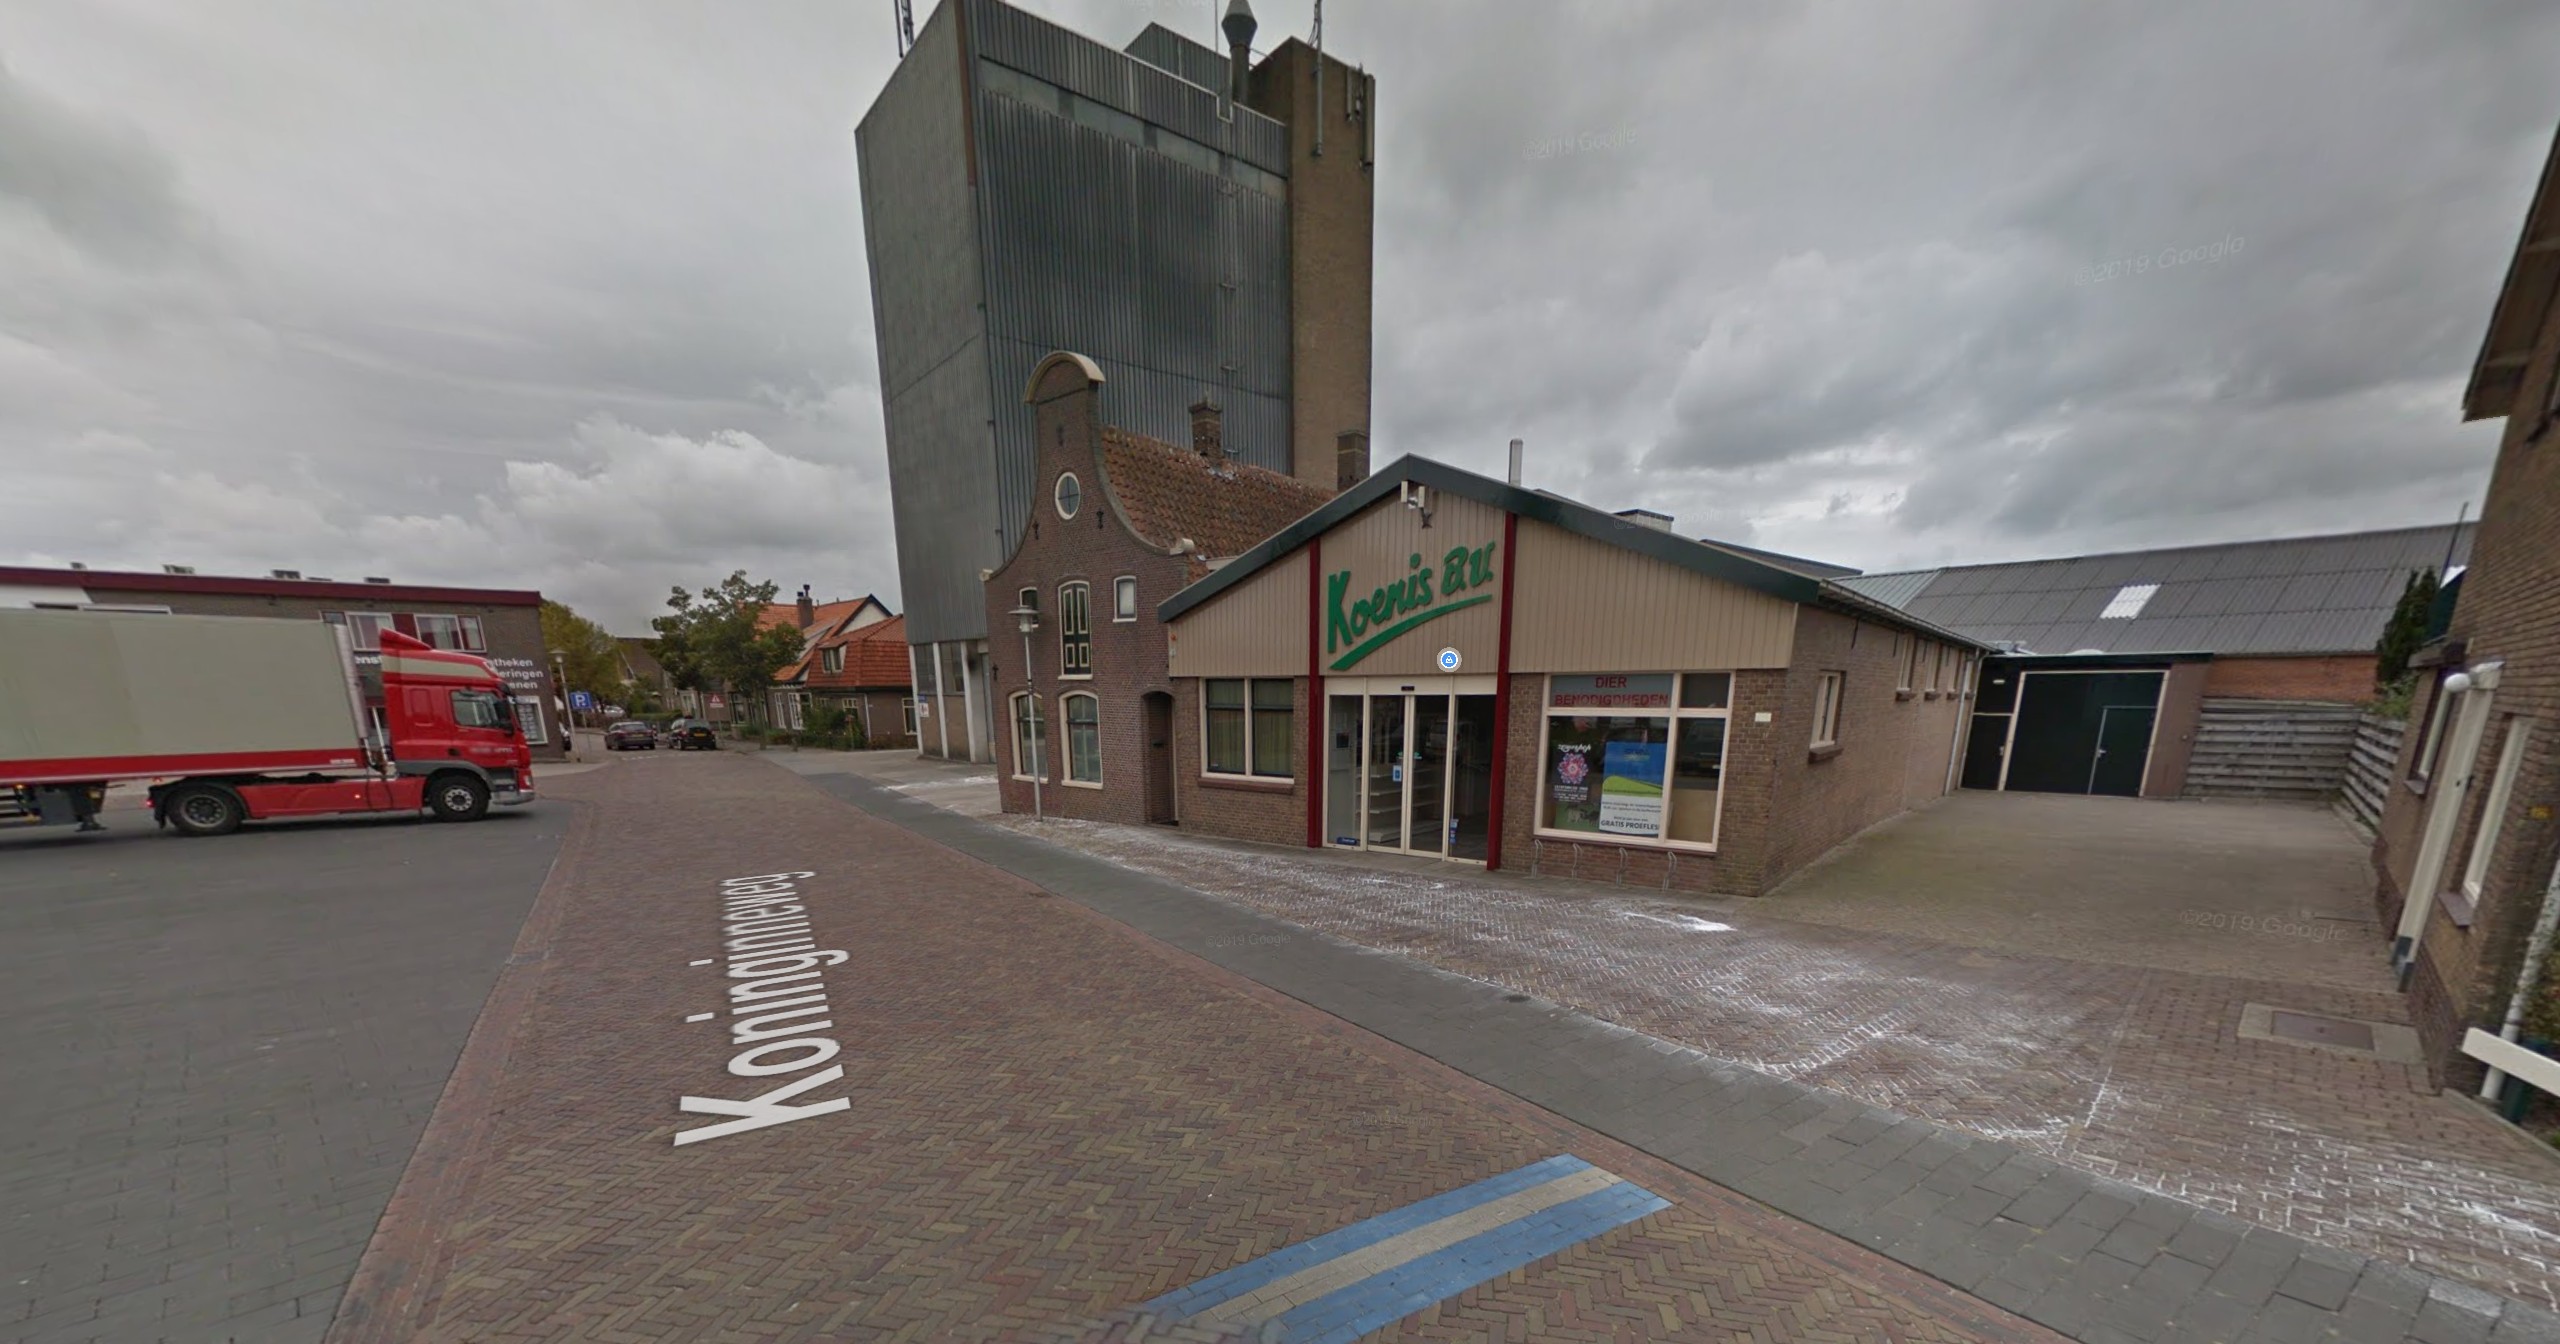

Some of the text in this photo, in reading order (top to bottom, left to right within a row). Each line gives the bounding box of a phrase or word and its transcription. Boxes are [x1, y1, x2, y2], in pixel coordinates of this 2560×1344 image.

[1328, 553, 1433, 654] Koenis
[1595, 676, 1628, 688] DIER
[1554, 693, 1669, 706] BENODIGDHEDEN
[1600, 820, 1625, 828] GRATIS
